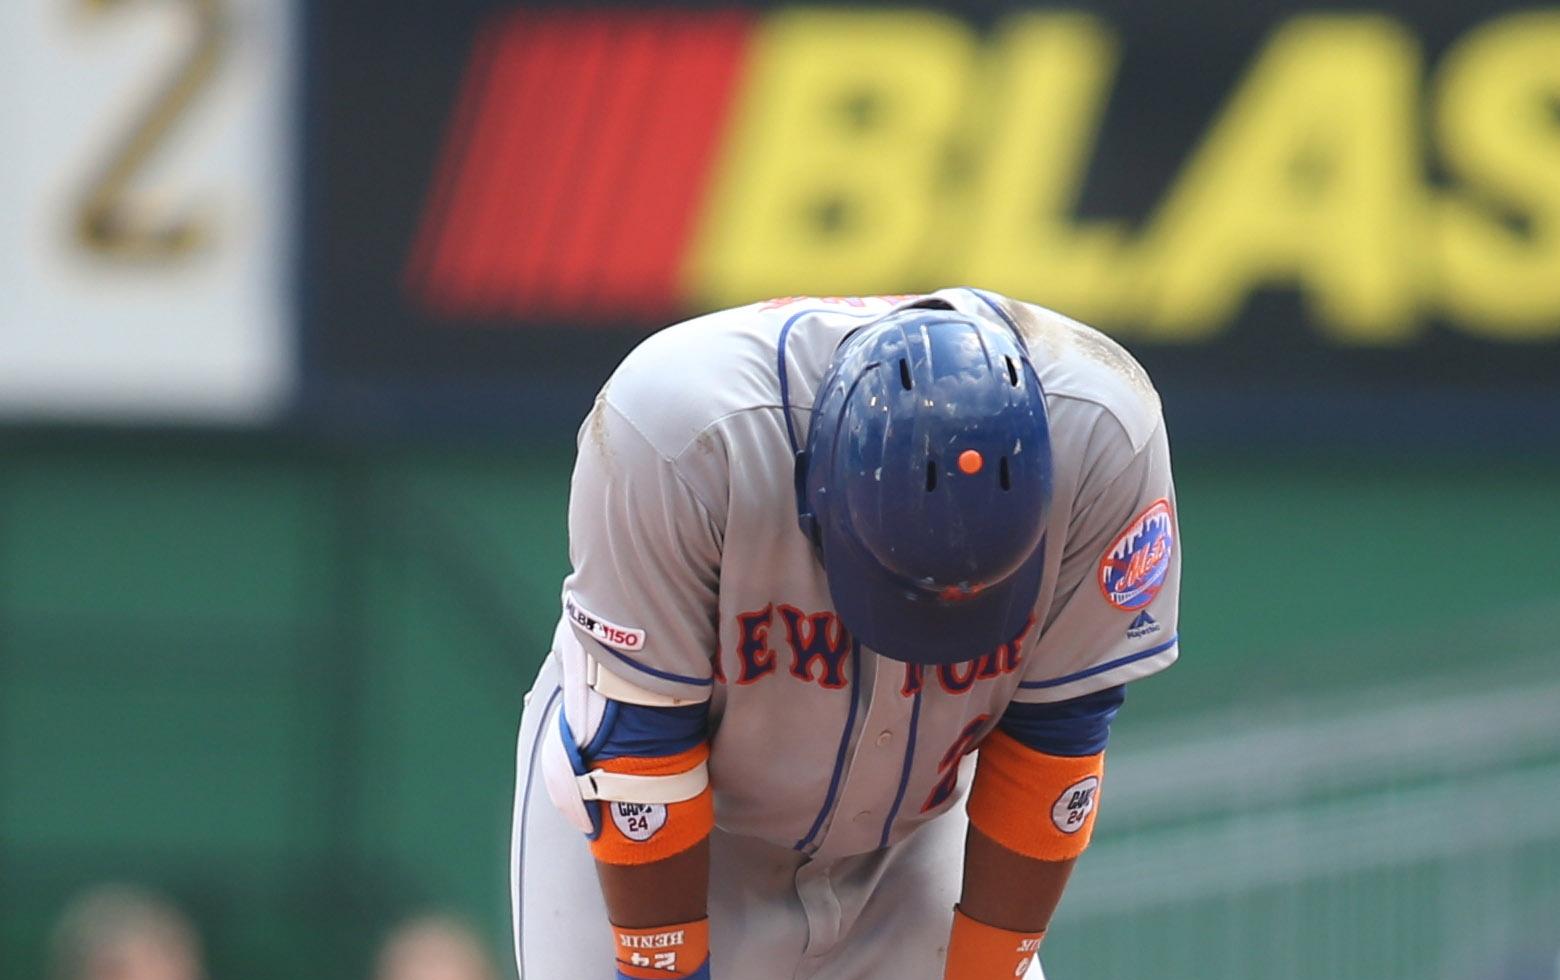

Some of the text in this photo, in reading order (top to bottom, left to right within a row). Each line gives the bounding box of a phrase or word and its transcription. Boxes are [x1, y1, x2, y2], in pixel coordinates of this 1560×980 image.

[64, 0, 232, 268] 2
[1115, 533, 1167, 592] Mets
[609, 628, 638, 646] 150
[716, 602, 848, 690] EW
[627, 816, 648, 832] 24
[1066, 808, 1085, 825] 24
